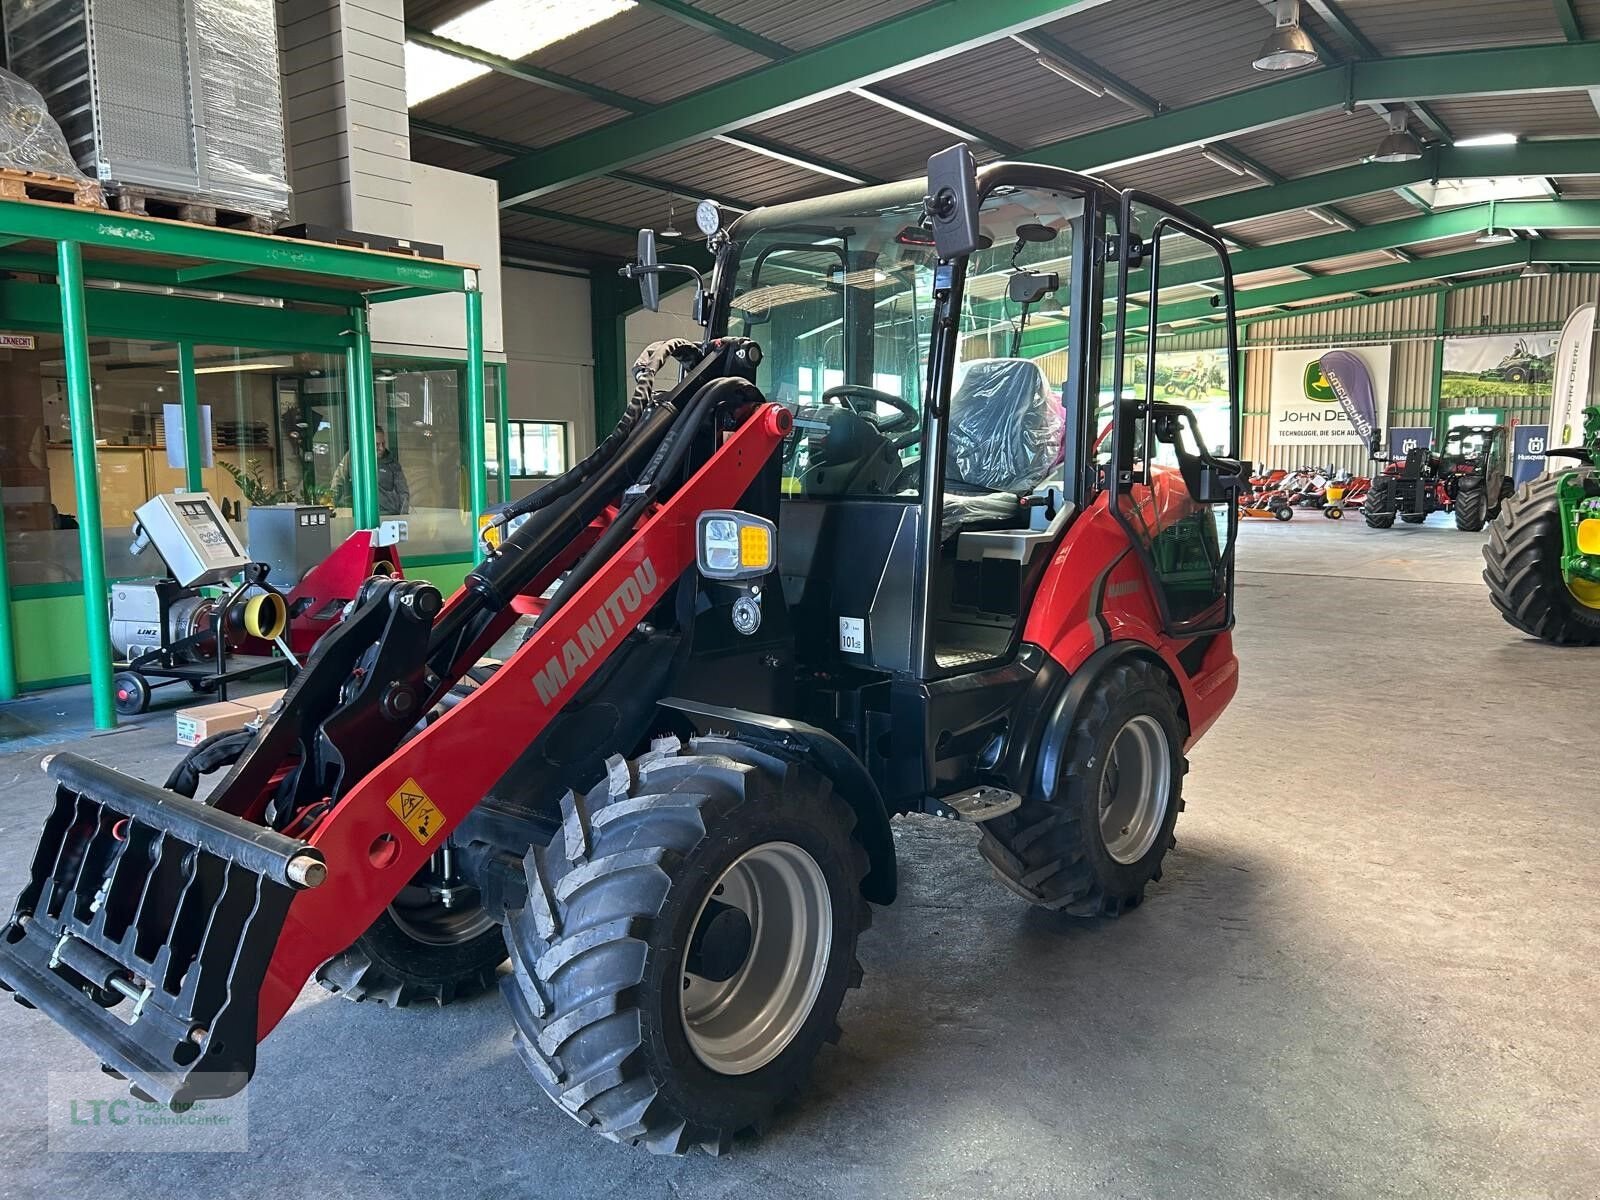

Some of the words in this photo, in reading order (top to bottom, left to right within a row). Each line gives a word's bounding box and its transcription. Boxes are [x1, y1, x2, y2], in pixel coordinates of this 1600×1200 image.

[1566, 385, 1574, 419] JOHN
[1280, 410, 1321, 422] JOHN
[1325, 409, 1349, 421] DE
[531, 557, 657, 707] MANITOU
[842, 636, 855, 648] 101
